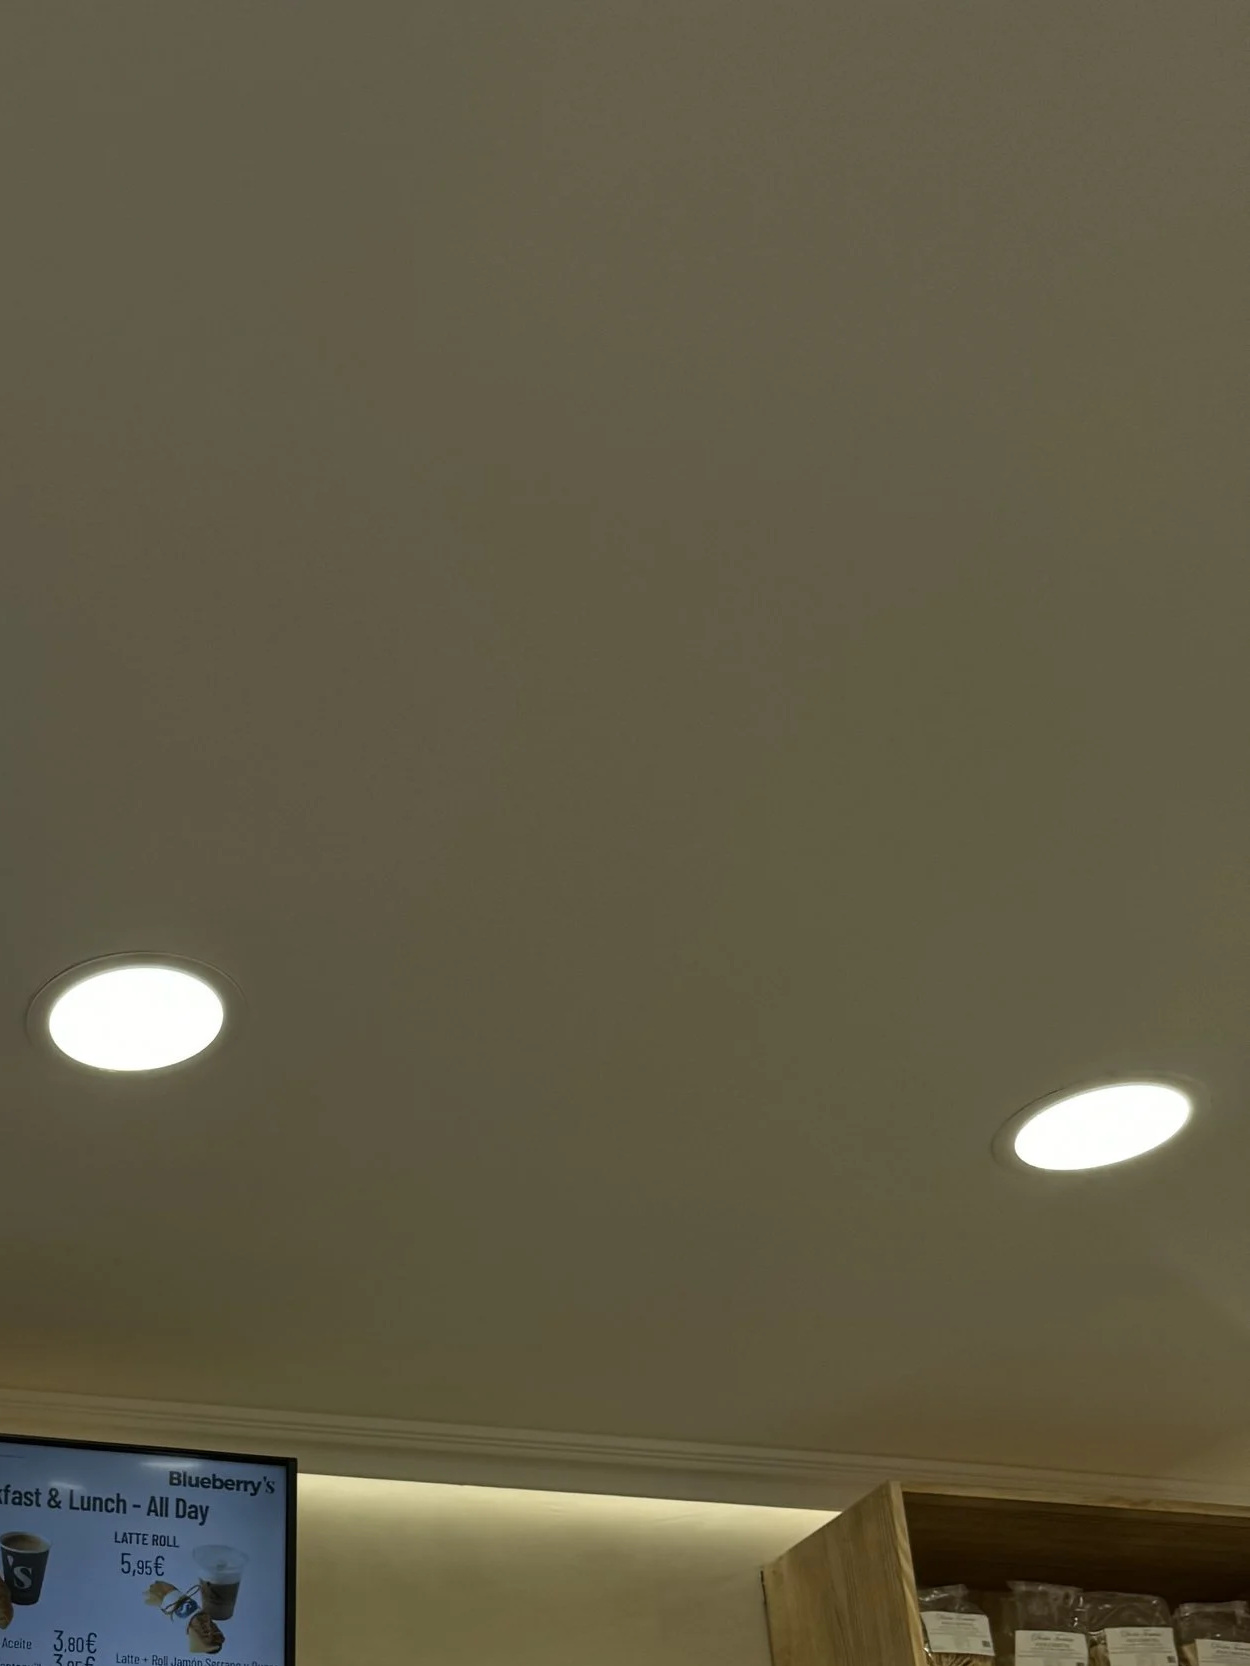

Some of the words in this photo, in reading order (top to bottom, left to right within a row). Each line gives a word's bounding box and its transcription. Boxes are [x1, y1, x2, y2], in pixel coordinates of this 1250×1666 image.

[169, 1471, 275, 1497] Blueberry's
[47, 1487, 62, 1509] &
[69, 1489, 127, 1514] Lunch
[146, 1496, 169, 1518] All
[175, 1497, 210, 1526] Day
[114, 1531, 149, 1546] LATTE
[151, 1534, 180, 1548] ROLL
[121, 1552, 165, 1577] 5,95€
[1, 1637, 32, 1650] Aceite
[53, 1630, 97, 1654] 3,80€
